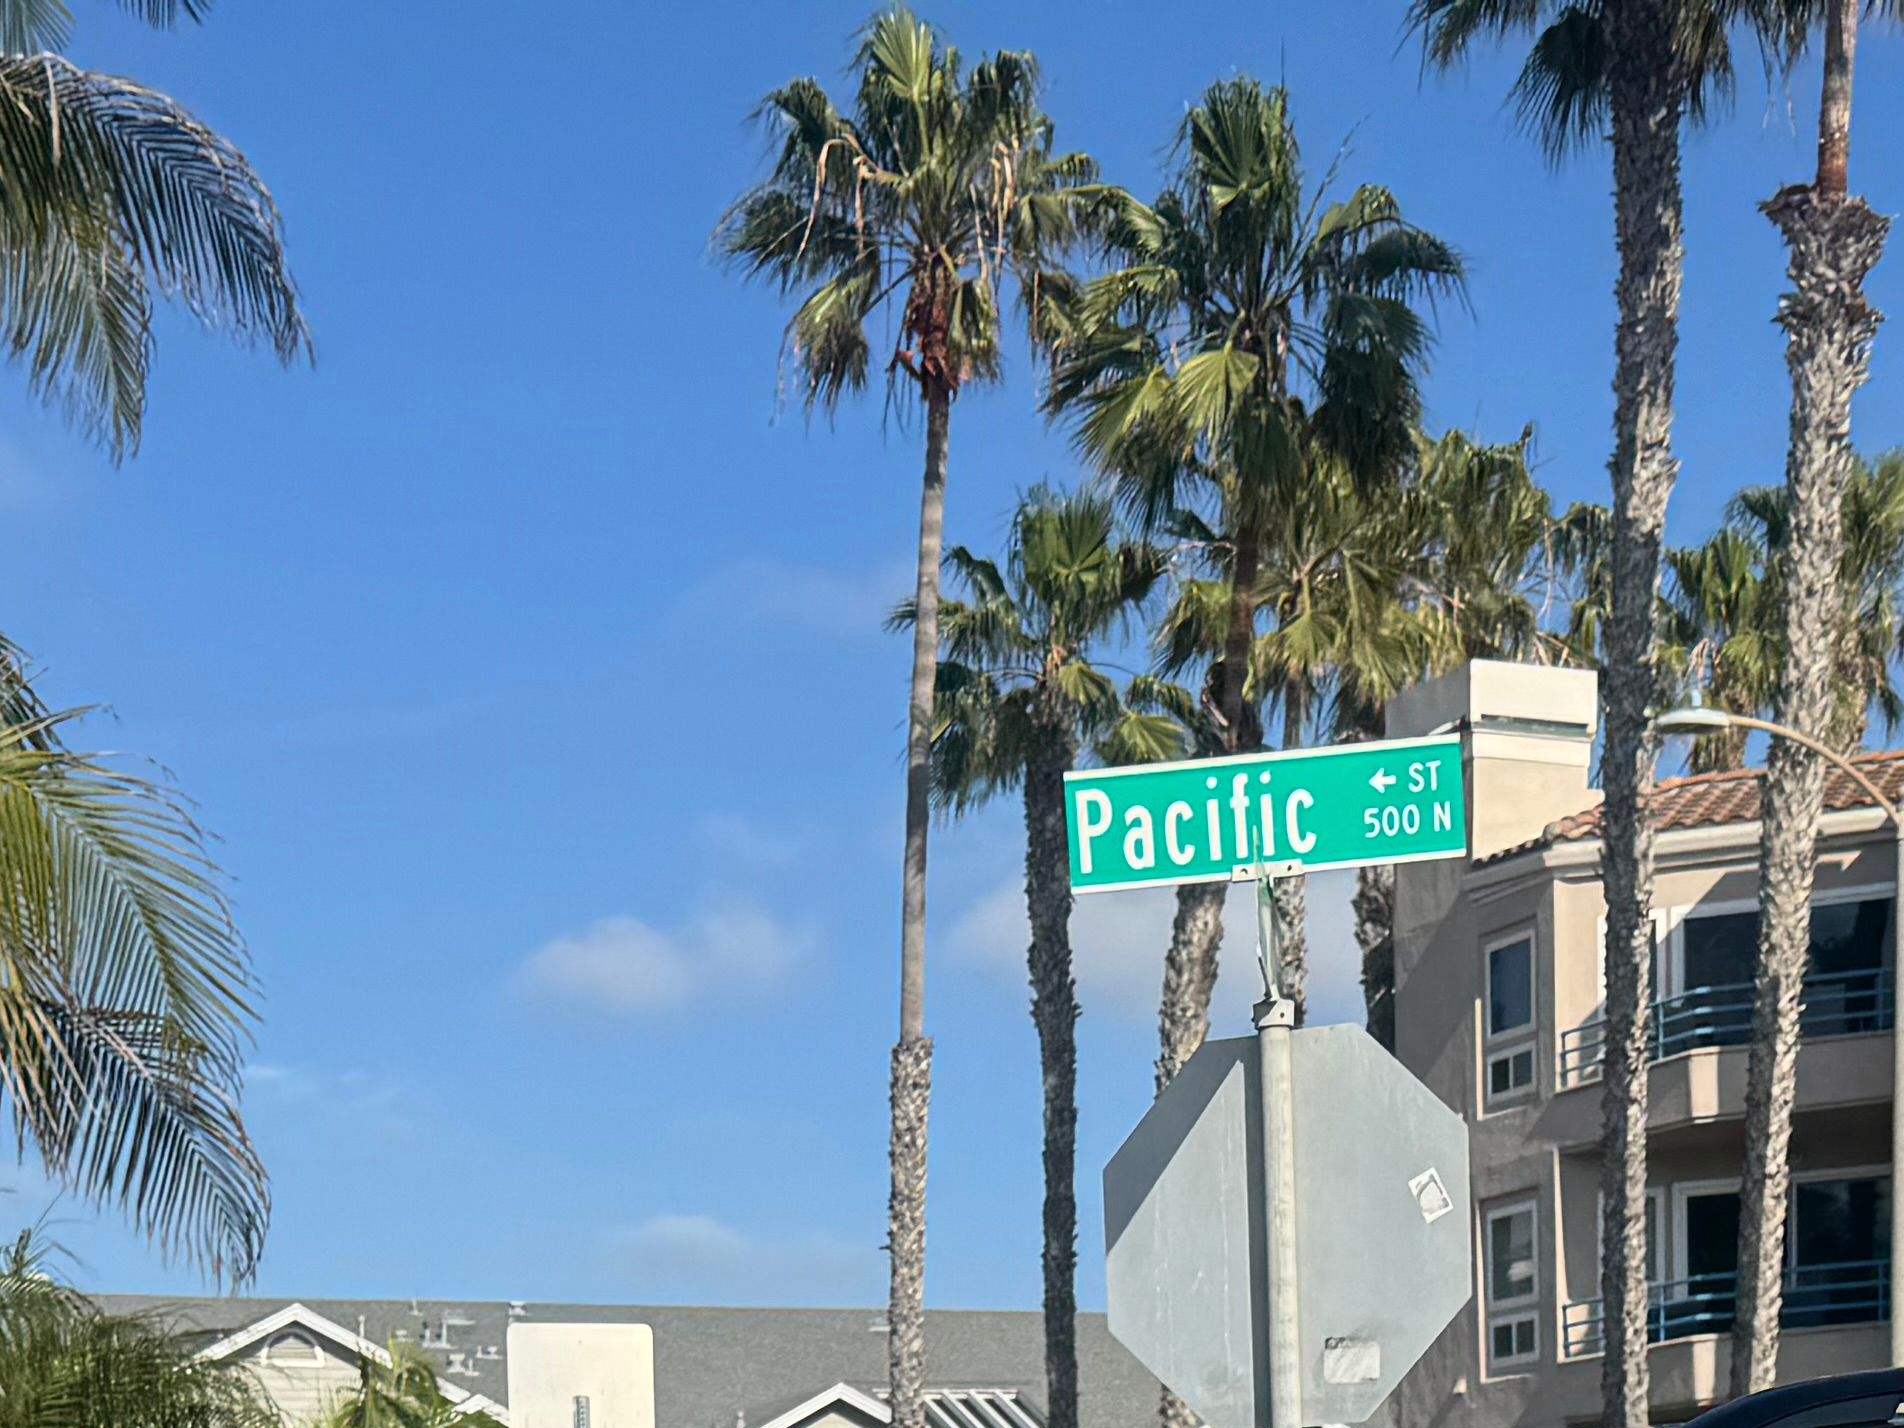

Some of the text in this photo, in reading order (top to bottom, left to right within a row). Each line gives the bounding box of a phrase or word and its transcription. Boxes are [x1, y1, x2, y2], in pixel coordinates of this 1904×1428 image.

[1408, 761, 1441, 793] ST
[1074, 770, 1317, 874] Pacific
[1363, 801, 1452, 839] 500 N
